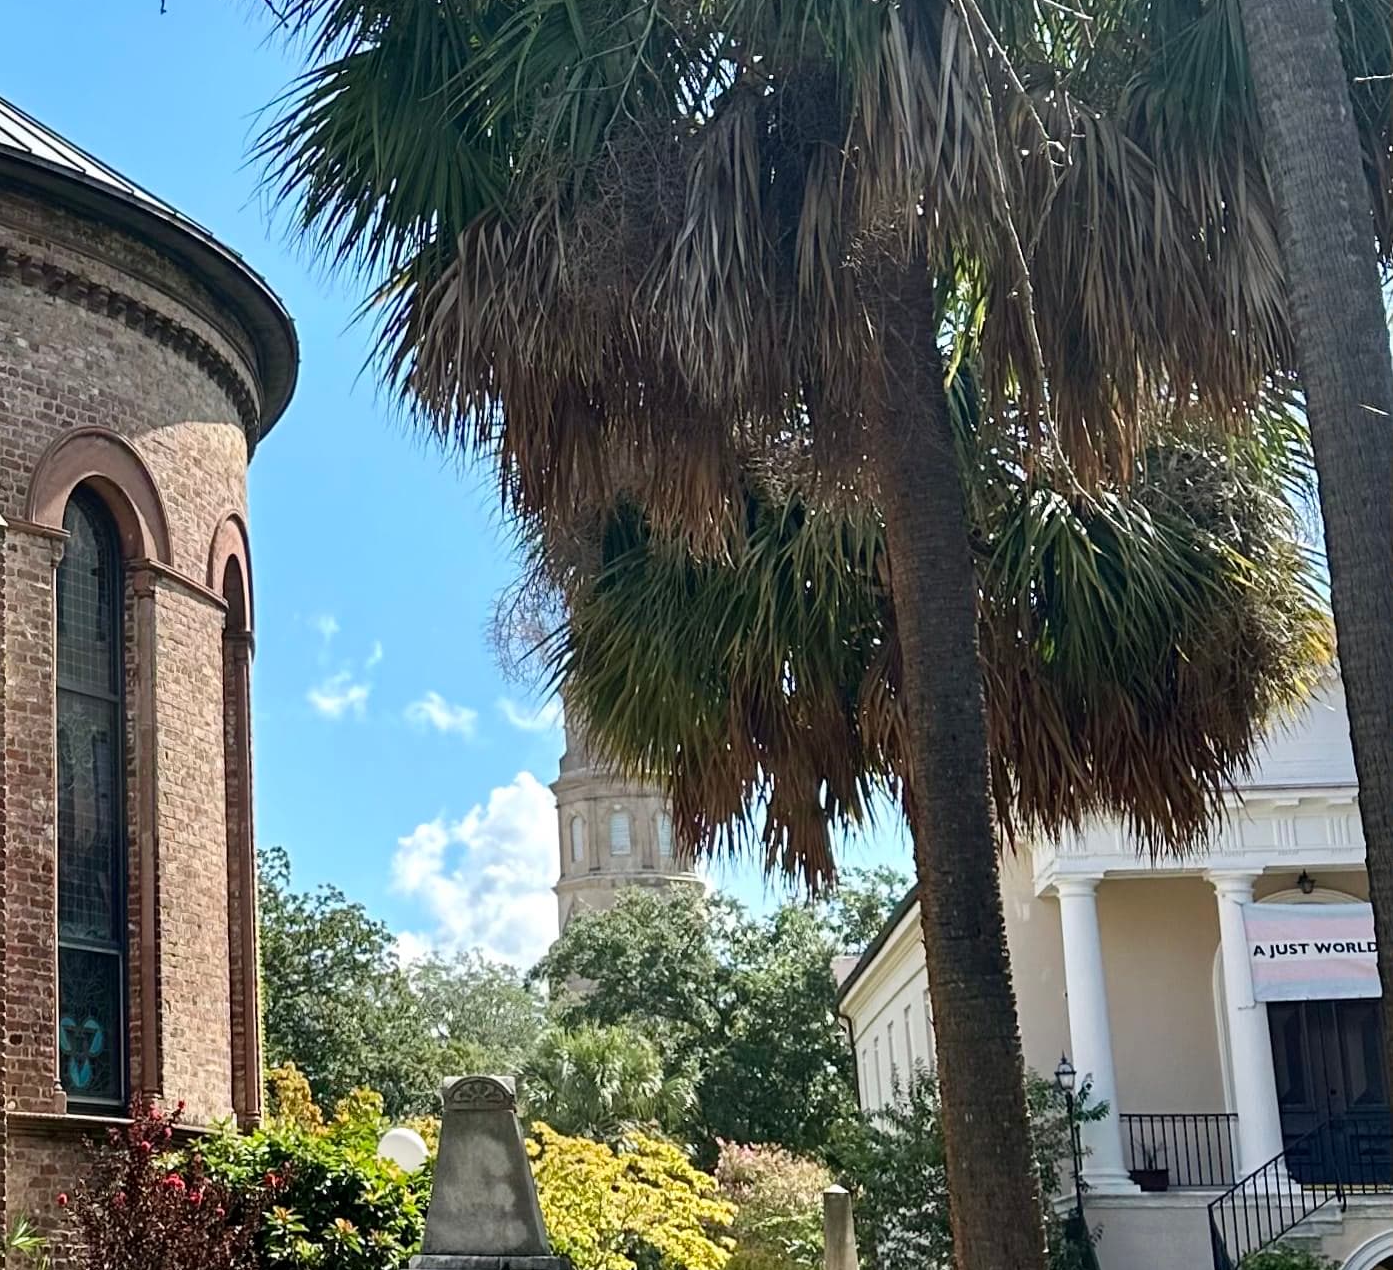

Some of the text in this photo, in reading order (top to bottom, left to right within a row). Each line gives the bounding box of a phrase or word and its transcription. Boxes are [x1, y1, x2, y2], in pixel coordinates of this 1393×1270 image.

[1253, 941, 1378, 958] A JUST WORLD
